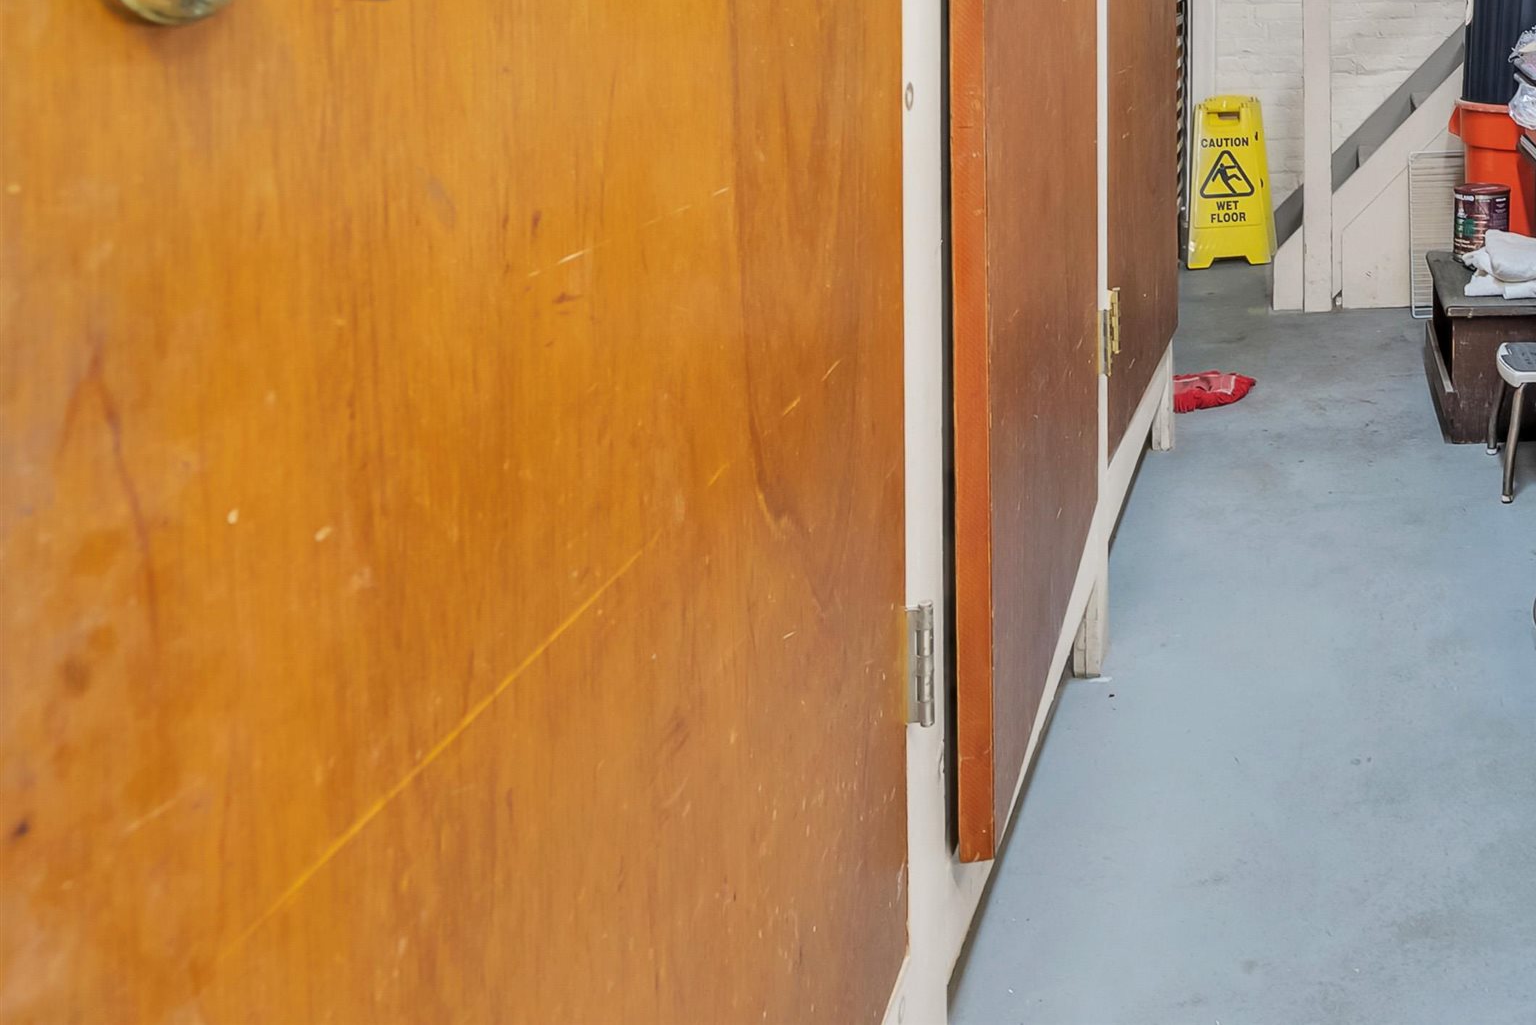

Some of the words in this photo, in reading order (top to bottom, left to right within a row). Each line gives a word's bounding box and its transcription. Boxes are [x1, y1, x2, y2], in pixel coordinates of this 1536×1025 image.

[1201, 137, 1249, 148] CAUTION
[1216, 200, 1239, 210] WET
[1210, 212, 1246, 223] FLOOR
